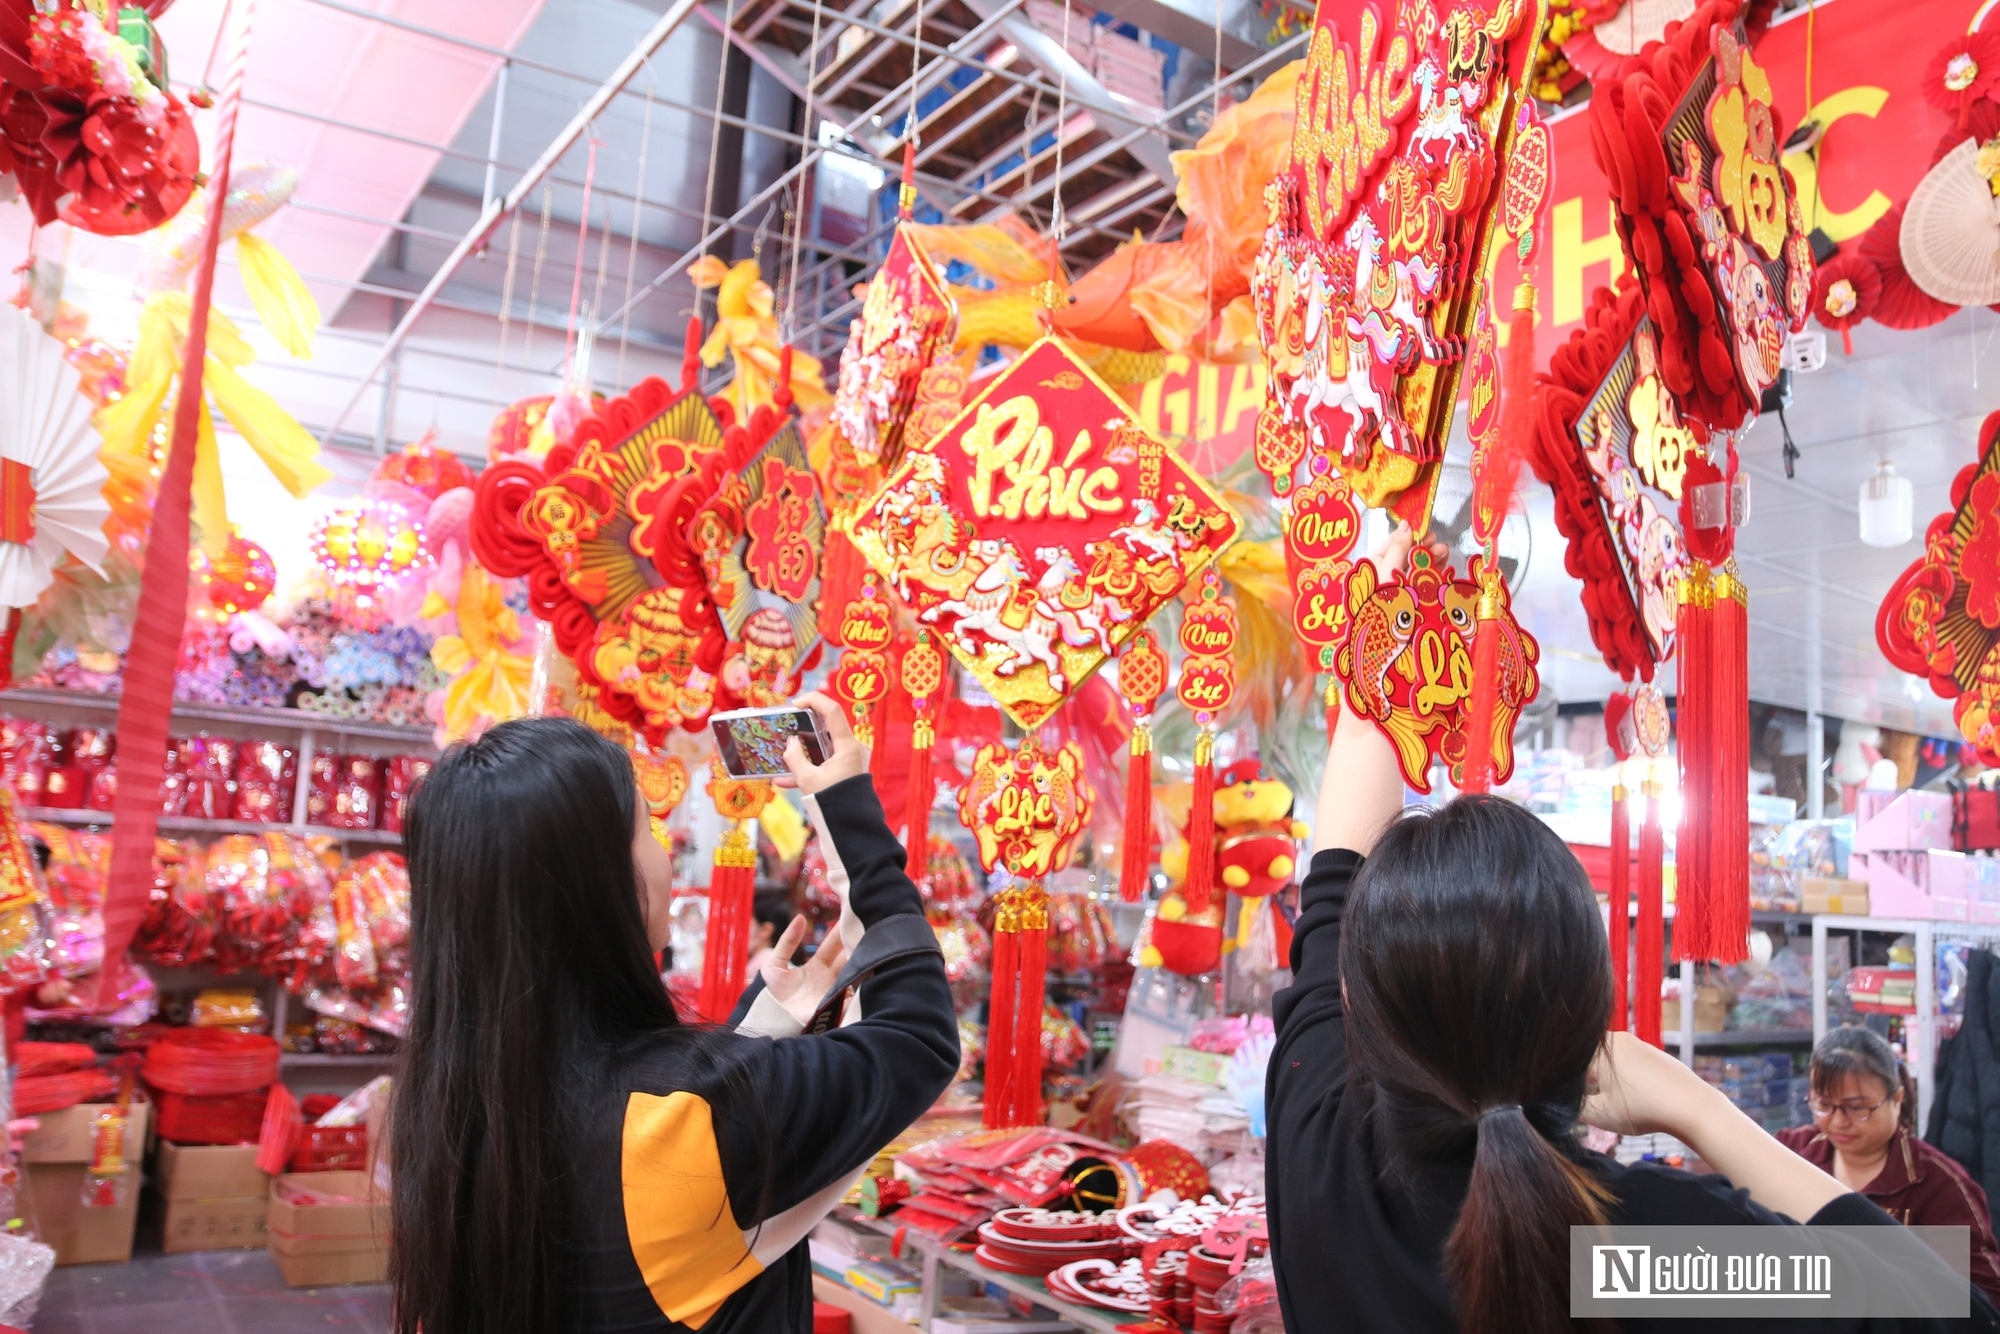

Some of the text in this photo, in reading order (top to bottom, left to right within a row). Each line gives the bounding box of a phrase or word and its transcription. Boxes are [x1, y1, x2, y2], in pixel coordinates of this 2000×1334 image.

[961, 395, 1124, 520] Phúc
[1138, 443, 1163, 458] Bát
[1297, 513, 1351, 548] Vạn
[843, 619, 888, 642] Như
[1184, 623, 1231, 650] Vạn
[847, 668, 877, 699] Ý
[1416, 628, 1475, 716] Lộ
[1184, 676, 1225, 705] Sự
[994, 785, 1055, 836] Lộc
